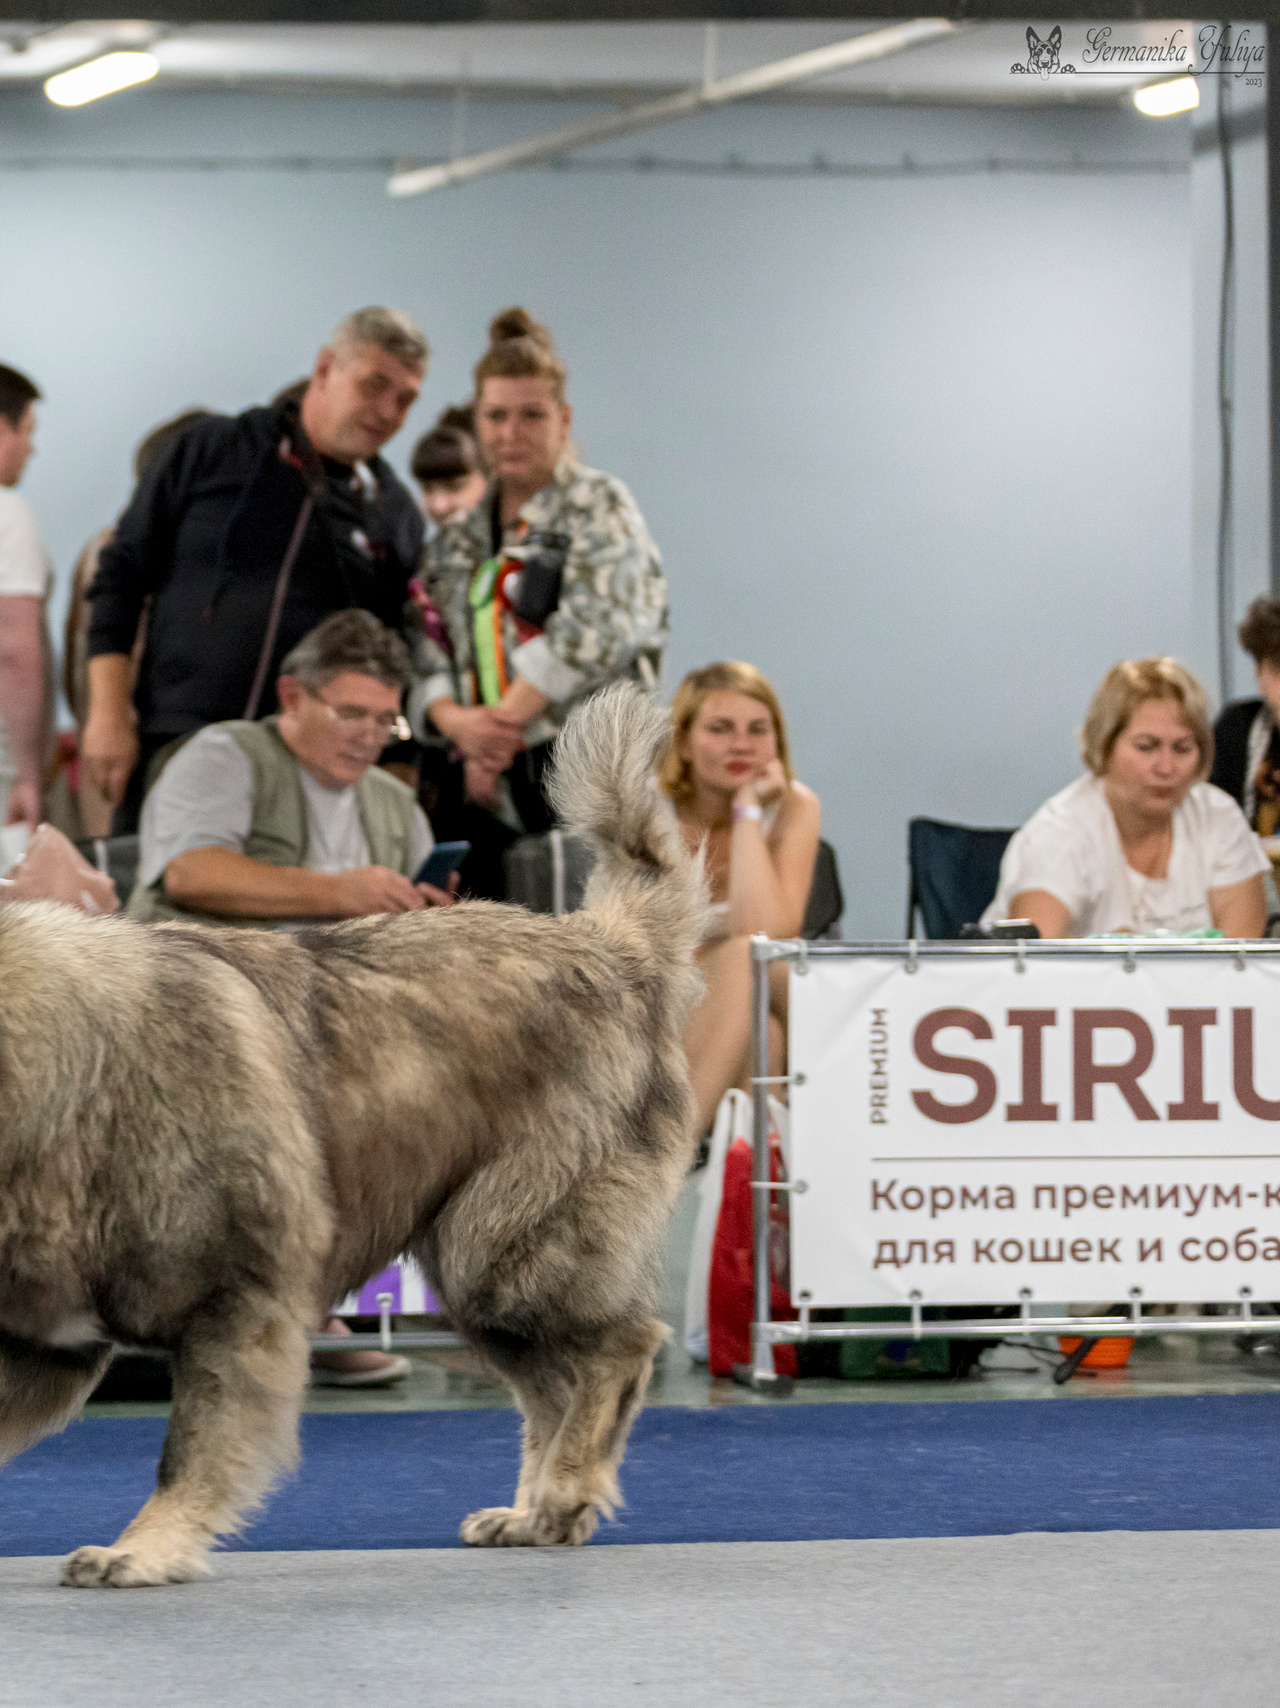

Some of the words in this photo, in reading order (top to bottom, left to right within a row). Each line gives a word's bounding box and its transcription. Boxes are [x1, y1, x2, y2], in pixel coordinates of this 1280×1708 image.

[869, 1008, 888, 1124] PREMIUM
[870, 1180, 1016, 1218] Корма
[873, 1237, 956, 1269] для
[972, 1237, 1123, 1264] кошек
[1138, 1237, 1163, 1263] и
[1180, 1227, 1280, 1263] соба
